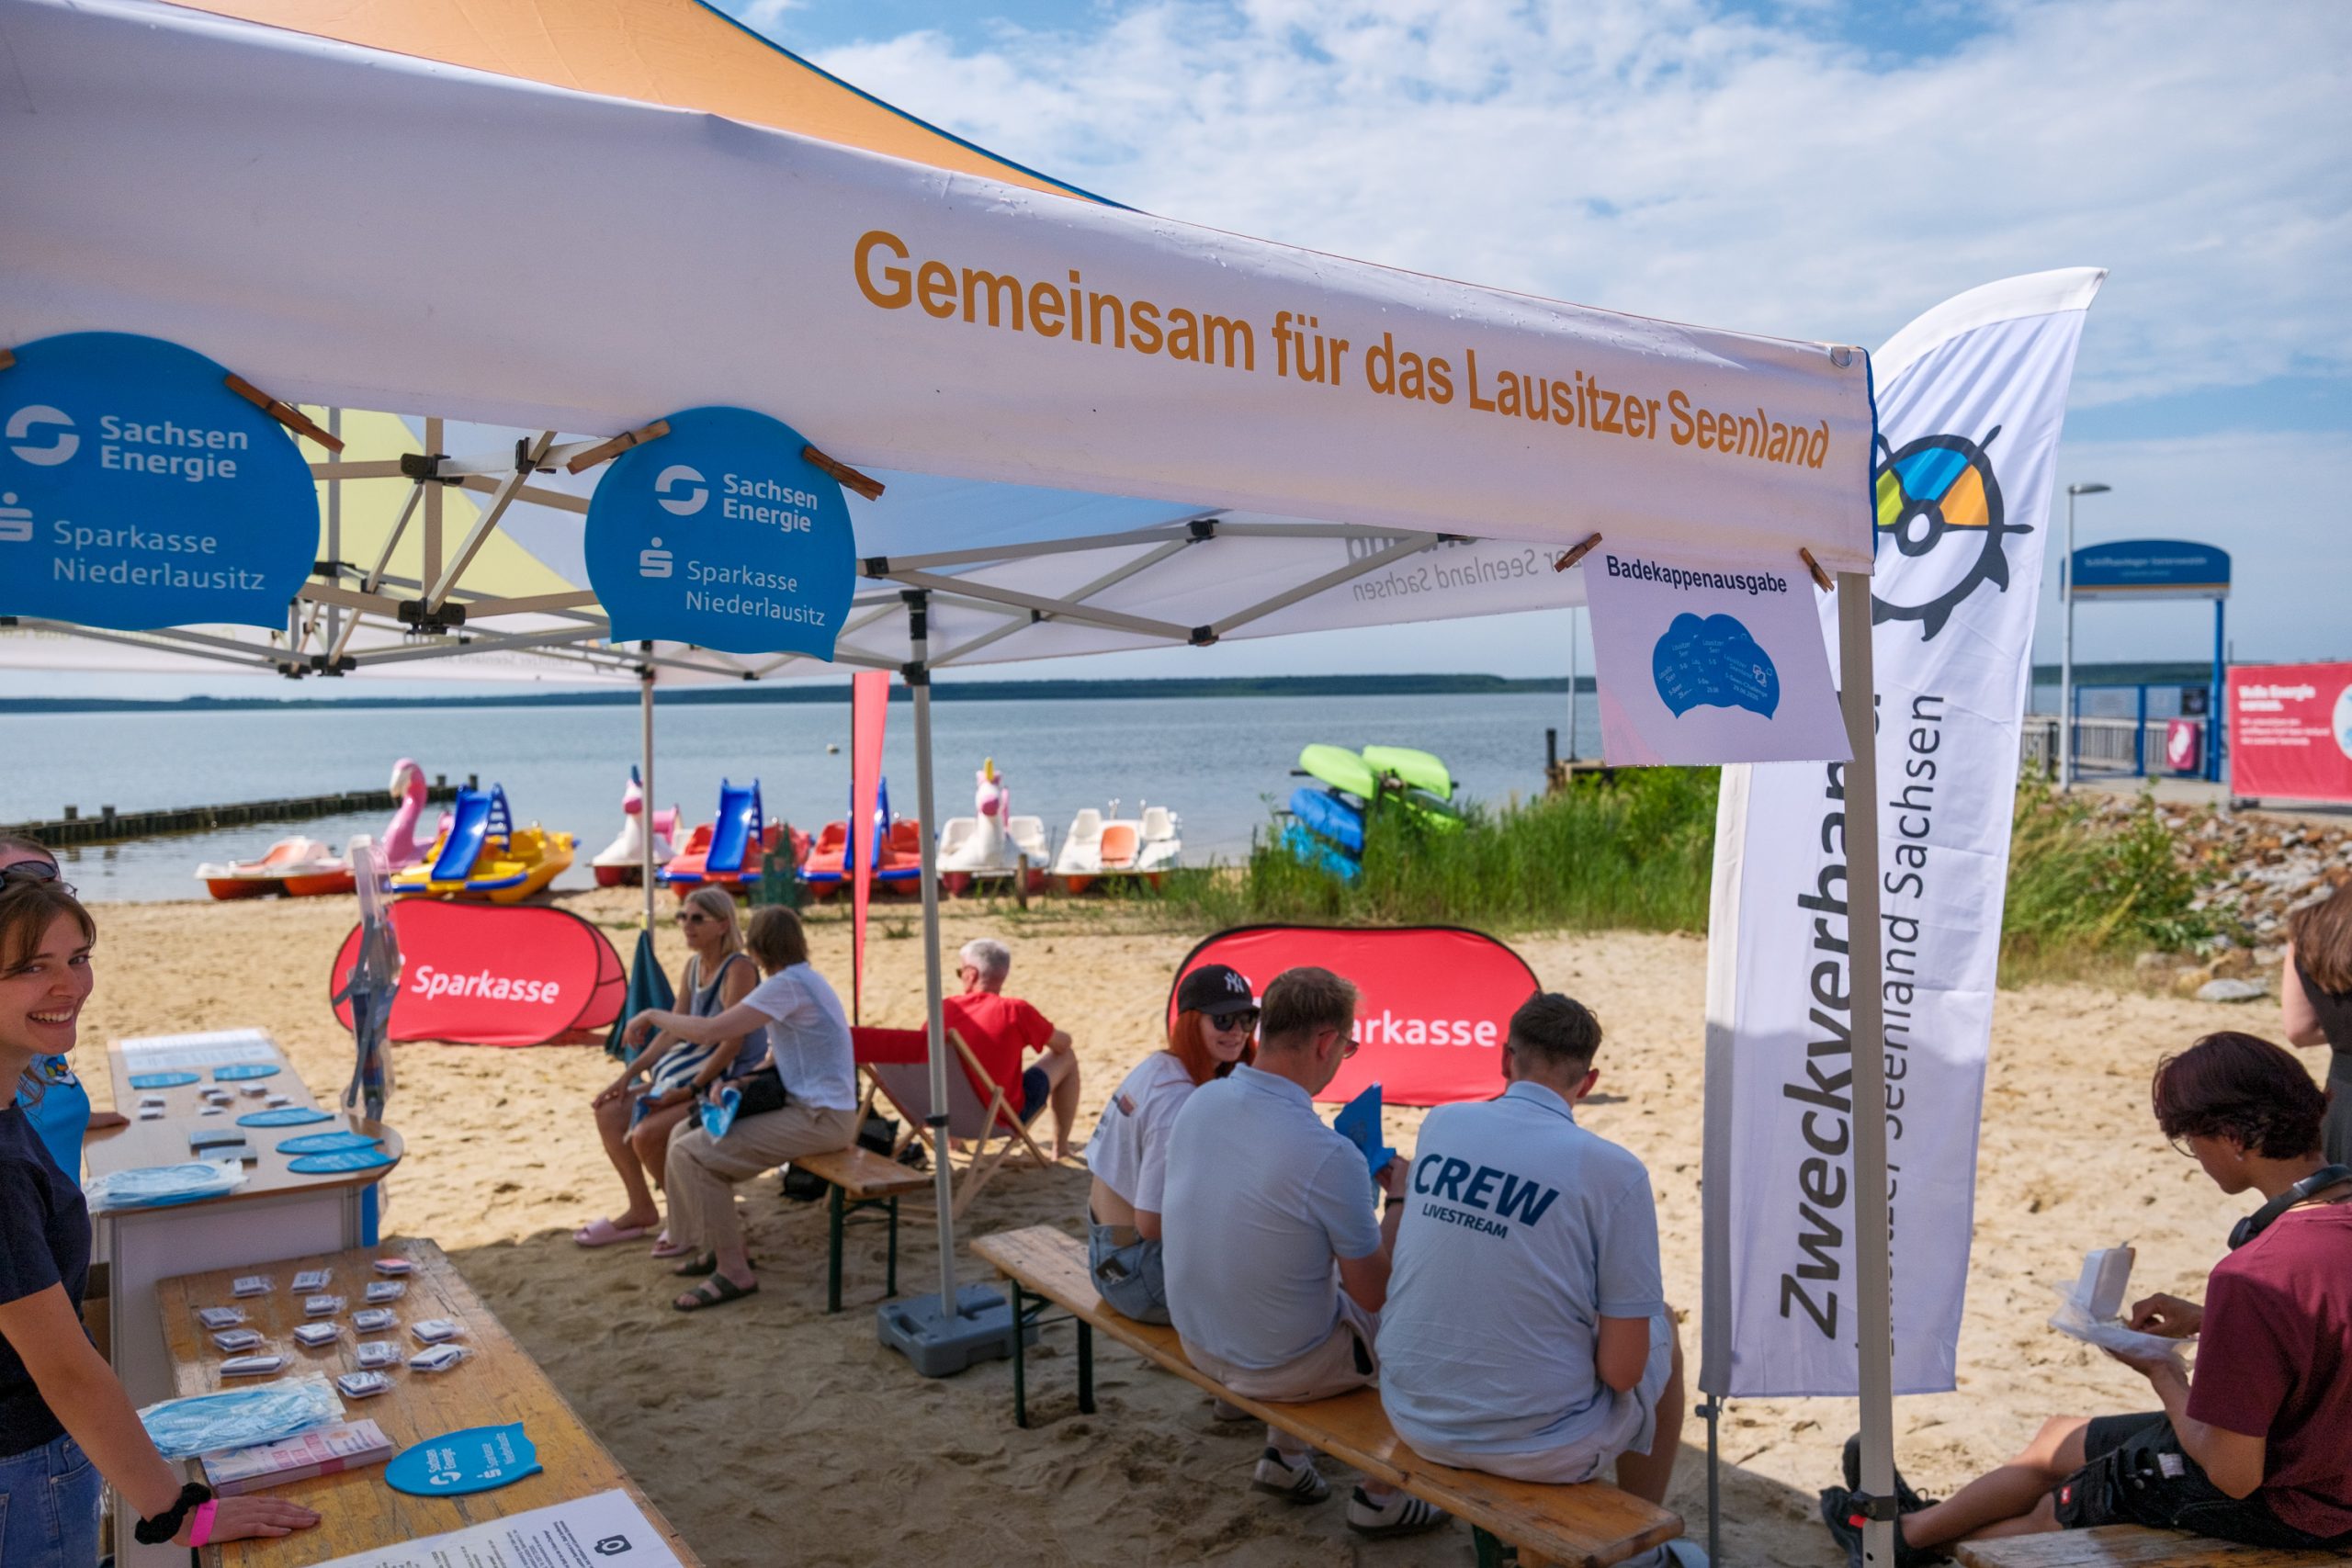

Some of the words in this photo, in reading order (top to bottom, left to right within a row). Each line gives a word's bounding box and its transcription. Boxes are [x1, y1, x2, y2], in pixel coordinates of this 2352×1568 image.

[854, 230, 1255, 372] Gemeinsam
[1272, 310, 1350, 387] für
[1365, 332, 1454, 405] das
[1466, 348, 1662, 441] Lausitzer
[1668, 389, 1830, 468] Seenland
[100, 415, 248, 450] Sachsen
[100, 445, 237, 481] Energie
[723, 473, 818, 510] Sachsen
[723, 499, 811, 533] Energie
[53, 520, 217, 554] Sparkasse
[53, 558, 266, 591] Niederlausitz
[686, 560, 797, 593] Sparkasse
[1606, 554, 1788, 596] Badekappenausgabe
[686, 591, 826, 627] Niederlausitz
[1883, 695, 1944, 898] Sachsen
[411, 964, 560, 1004] Sparkasse
[1413, 1153, 1560, 1228] CREW
[1422, 1201, 1510, 1239] LIVESTREAM
